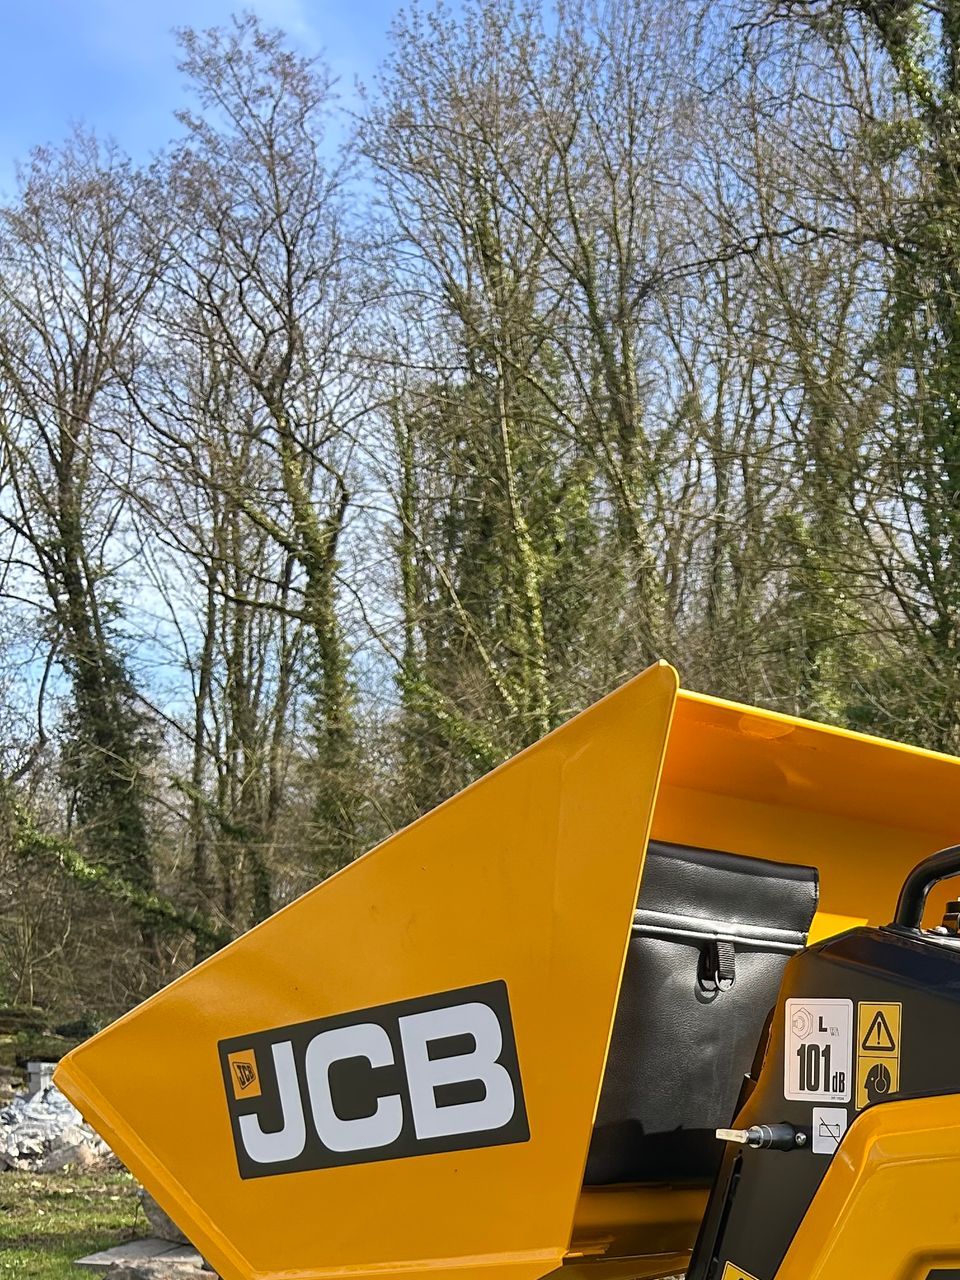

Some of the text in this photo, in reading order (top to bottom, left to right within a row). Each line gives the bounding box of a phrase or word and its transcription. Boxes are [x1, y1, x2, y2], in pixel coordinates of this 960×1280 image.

[236, 1064, 255, 1086] JCB
[239, 1002, 515, 1163] JCB
[797, 1044, 831, 1092] 101
